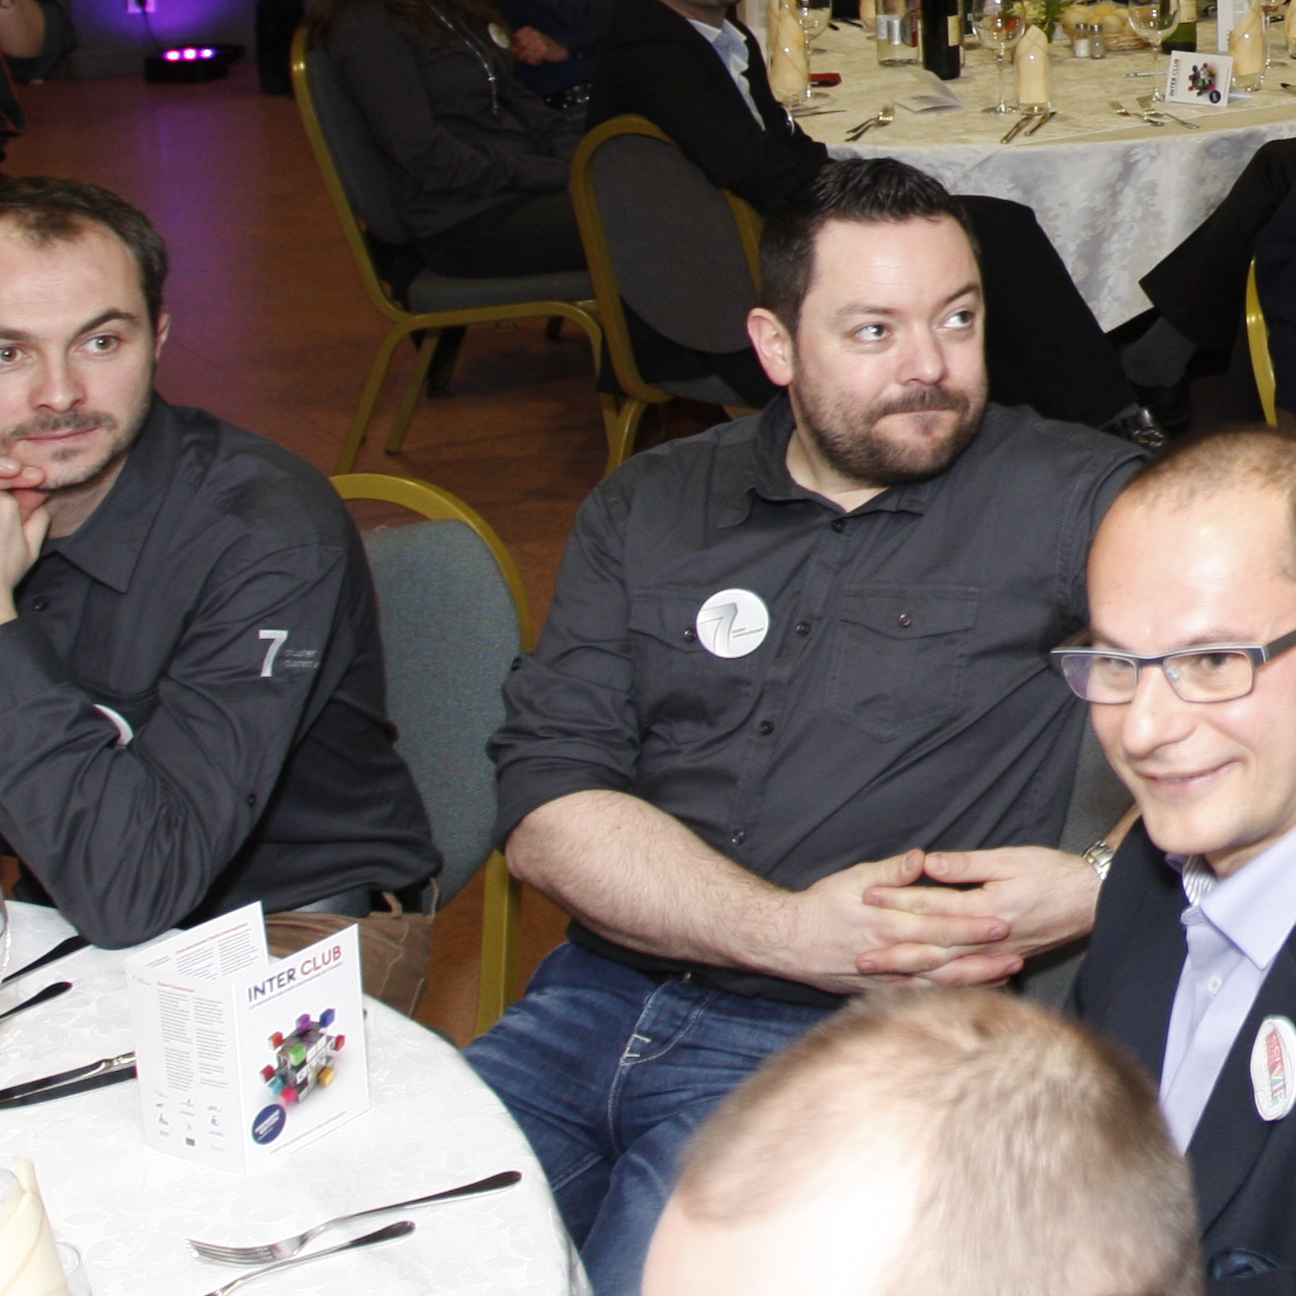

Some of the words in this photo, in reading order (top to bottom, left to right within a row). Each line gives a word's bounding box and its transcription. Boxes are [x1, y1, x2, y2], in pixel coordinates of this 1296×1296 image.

[259, 630, 288, 677] 7
[248, 968, 296, 1002] INTER
[300, 945, 342, 976] CLUB
